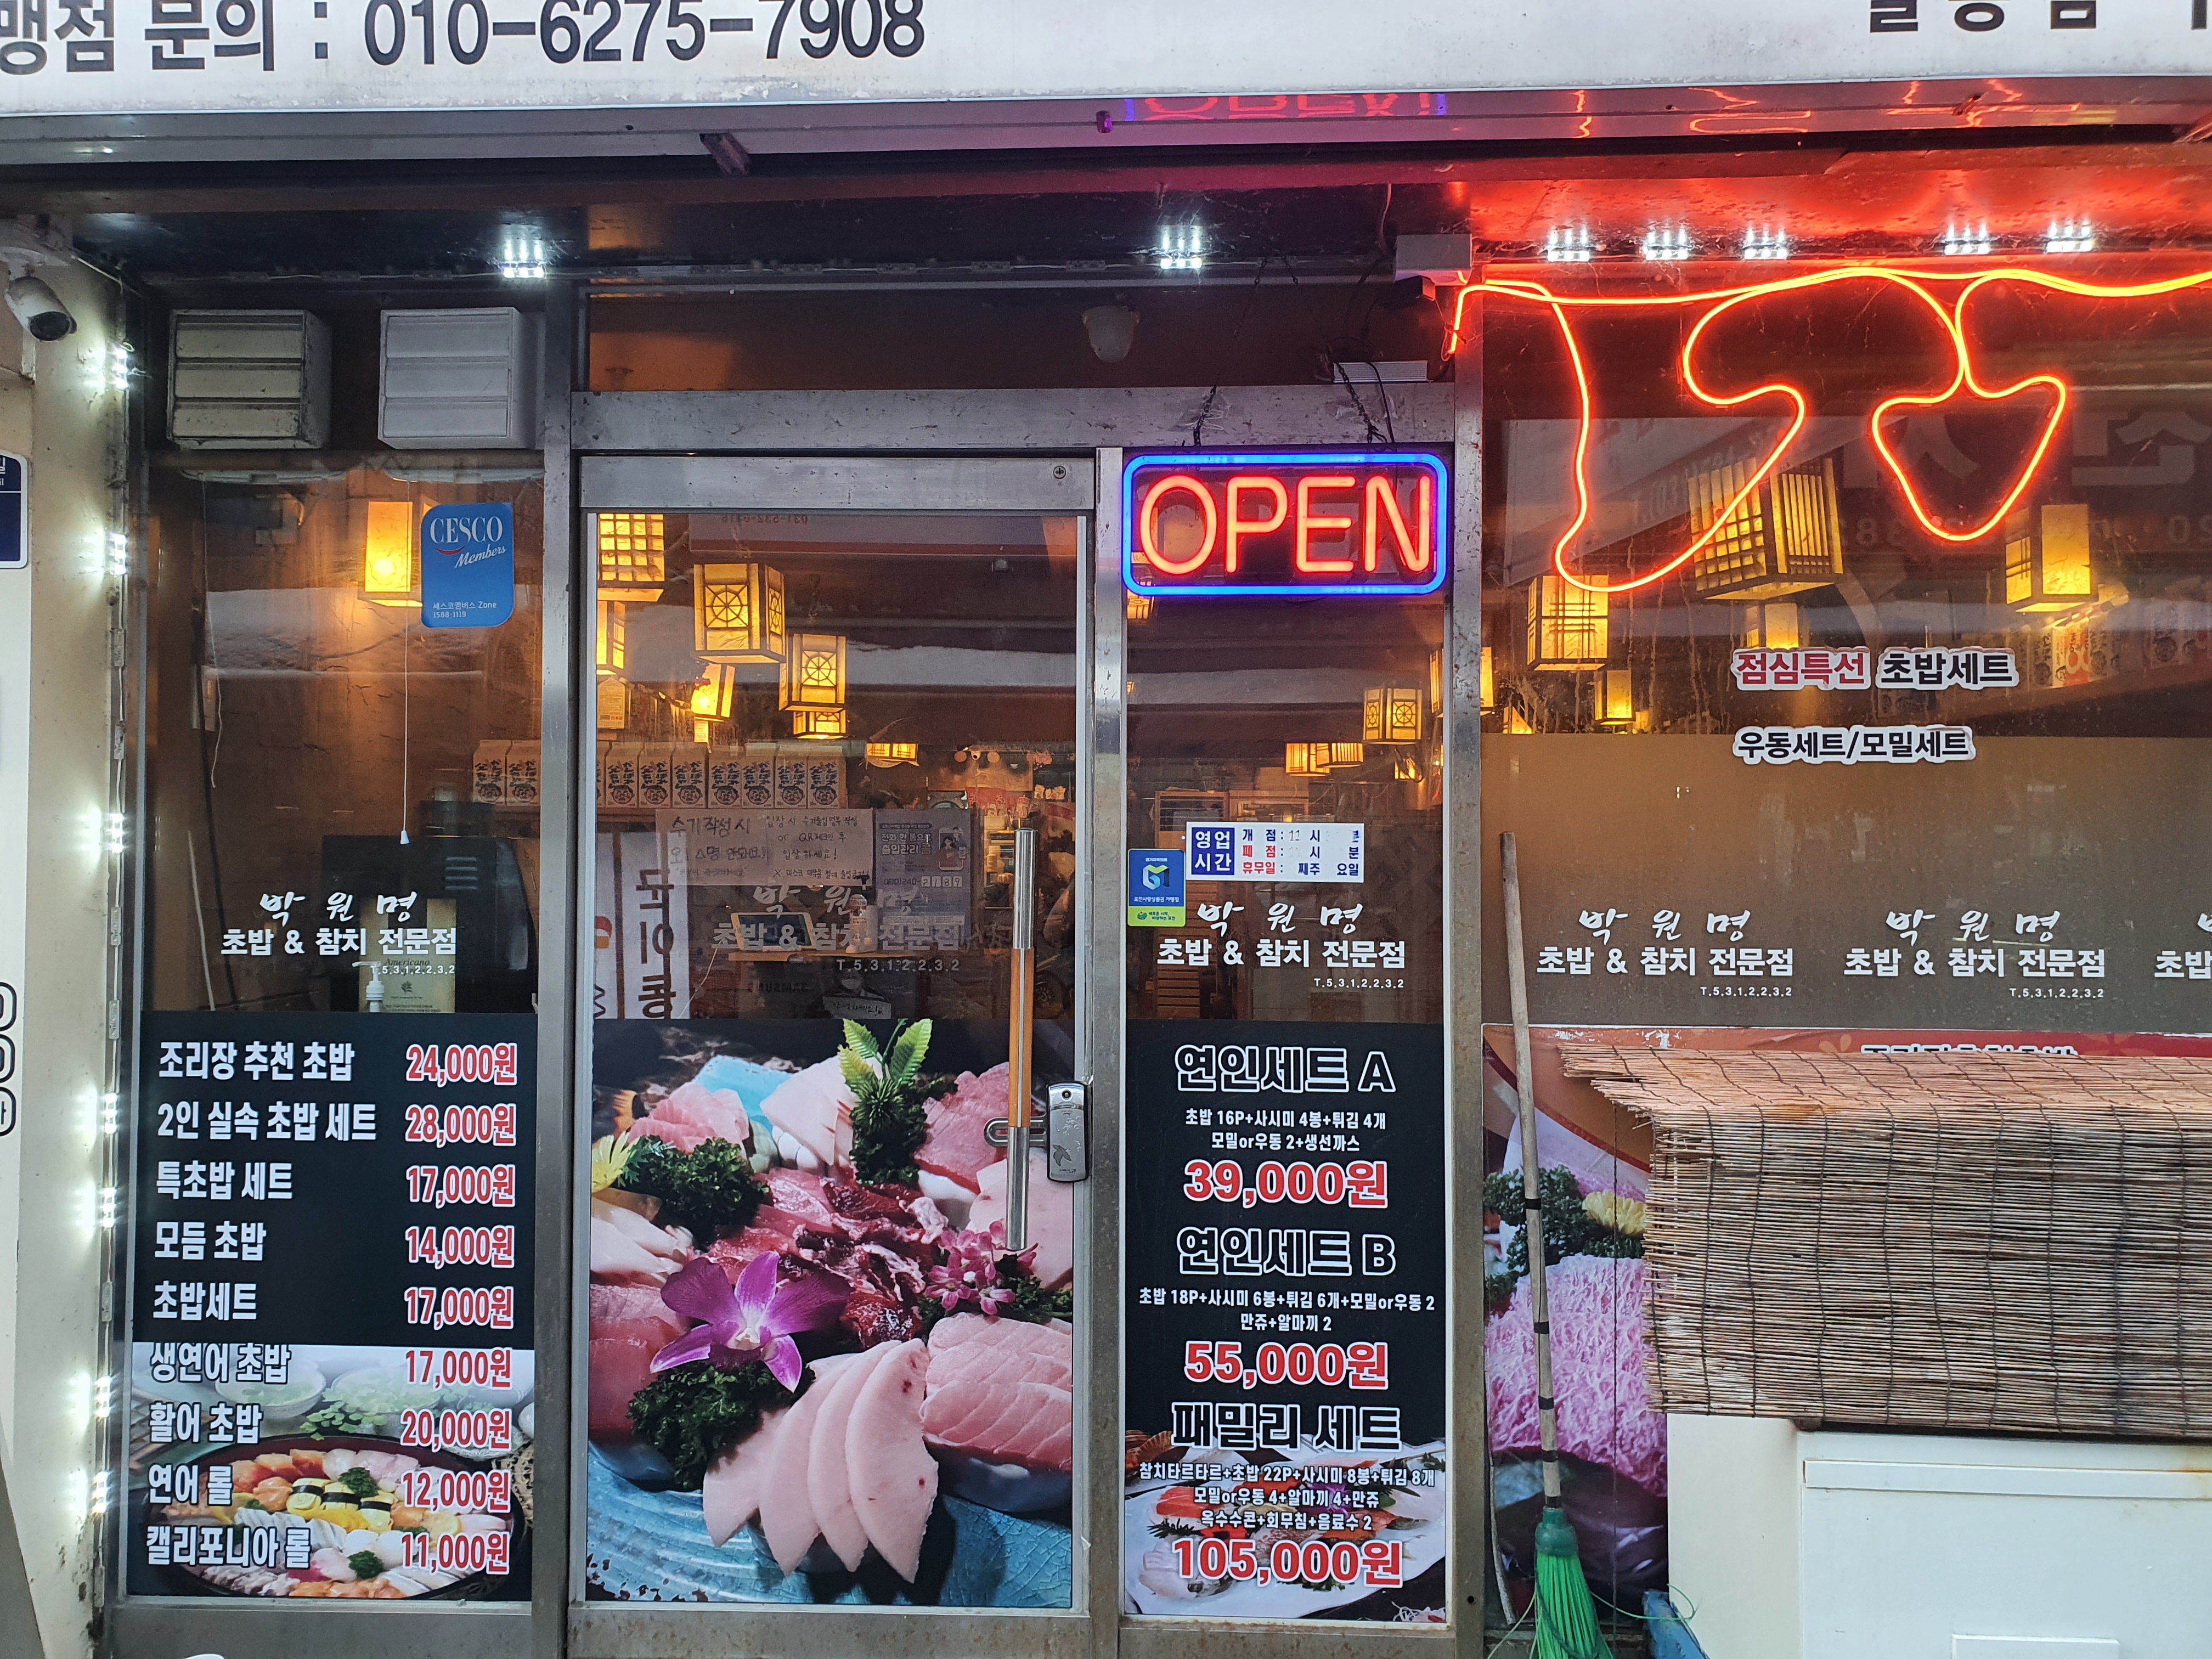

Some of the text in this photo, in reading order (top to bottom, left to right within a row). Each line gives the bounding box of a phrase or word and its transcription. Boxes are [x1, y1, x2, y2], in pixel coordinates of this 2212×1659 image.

[145, 0, 274, 71] 문의
[366, 0, 925, 65] 010-6275-7908
[430, 516, 503, 544] CESCO
[1140, 475, 1430, 574] OPEN
[454, 543, 506, 568] Members
[432, 602, 476, 610] 세스코멤버스
[1737, 653, 2012, 685] 점심특선 초밥세트
[1737, 731, 1969, 759] 우동세트/모밀세트
[1195, 831, 1231, 850] 영업
[1310, 830, 1320, 842] 시
[1194, 853, 1232, 872] 시간
[1310, 846, 1320, 859] 시
[1348, 847, 1359, 859] 분
[1298, 863, 1320, 875] 째주
[1336, 863, 1359, 876] 요일
[221, 928, 456, 956] 초밥 & 참치 전문점
[1157, 939, 1404, 968] 초밥 & 참치 전문점
[1537, 946, 1793, 976] 초밥 & 참치 전문점
[1843, 948, 2104, 978] 초밥 & 참치 전문점
[2154, 950, 2211, 979] 초밥
[159, 1042, 517, 1086] 조리장 추천 초밥 24,000원
[1175, 1045, 1396, 1093] 연인세트 A
[157, 1101, 517, 1148] 2인 실속 초밥 세트 28,000원
[1185, 1108, 1386, 1130] 초밥 16P+사시미 4봉+튀김 4개
[1211, 1132, 1360, 1152] 모밀or우동 2+생선까스
[156, 1161, 516, 1209] 특초밥 세트 17,000원
[1183, 1159, 1388, 1209] 39,000원
[154, 1221, 515, 1269] 모듬 초밥 14,000원
[1177, 1227, 1396, 1276] 연인세트 B
[153, 1281, 514, 1330] 초밥세트 17,000원
[1139, 1287, 1435, 1311] 초밥 18P+사시미 6봉+튀김 6개+모밀or우동 2
[1240, 1314, 1332, 1332] 만쥬+알마끼 2
[150, 1342, 512, 1390] 생연어 초밥 17,000원
[1184, 1340, 1389, 1390] 55,000원
[148, 1402, 512, 1452] 활어 초밥 20,000원
[1171, 1402, 1402, 1452] 패밀리 세트
[148, 1463, 511, 1513] 연어 롤 12,000원
[1139, 1462, 1435, 1487] 참치타르타르+초밥 22P+사시미 8봉+튀김 8개
[1194, 1487, 1379, 1509] 모밀or우동 4+알마끼 4+만쥬
[1201, 1510, 1372, 1531] 옥수수콘+회무침+음료수 2
[146, 1525, 510, 1575] 캘리포니아 롤 11,000원
[1172, 1538, 1403, 1588] 105,000원
